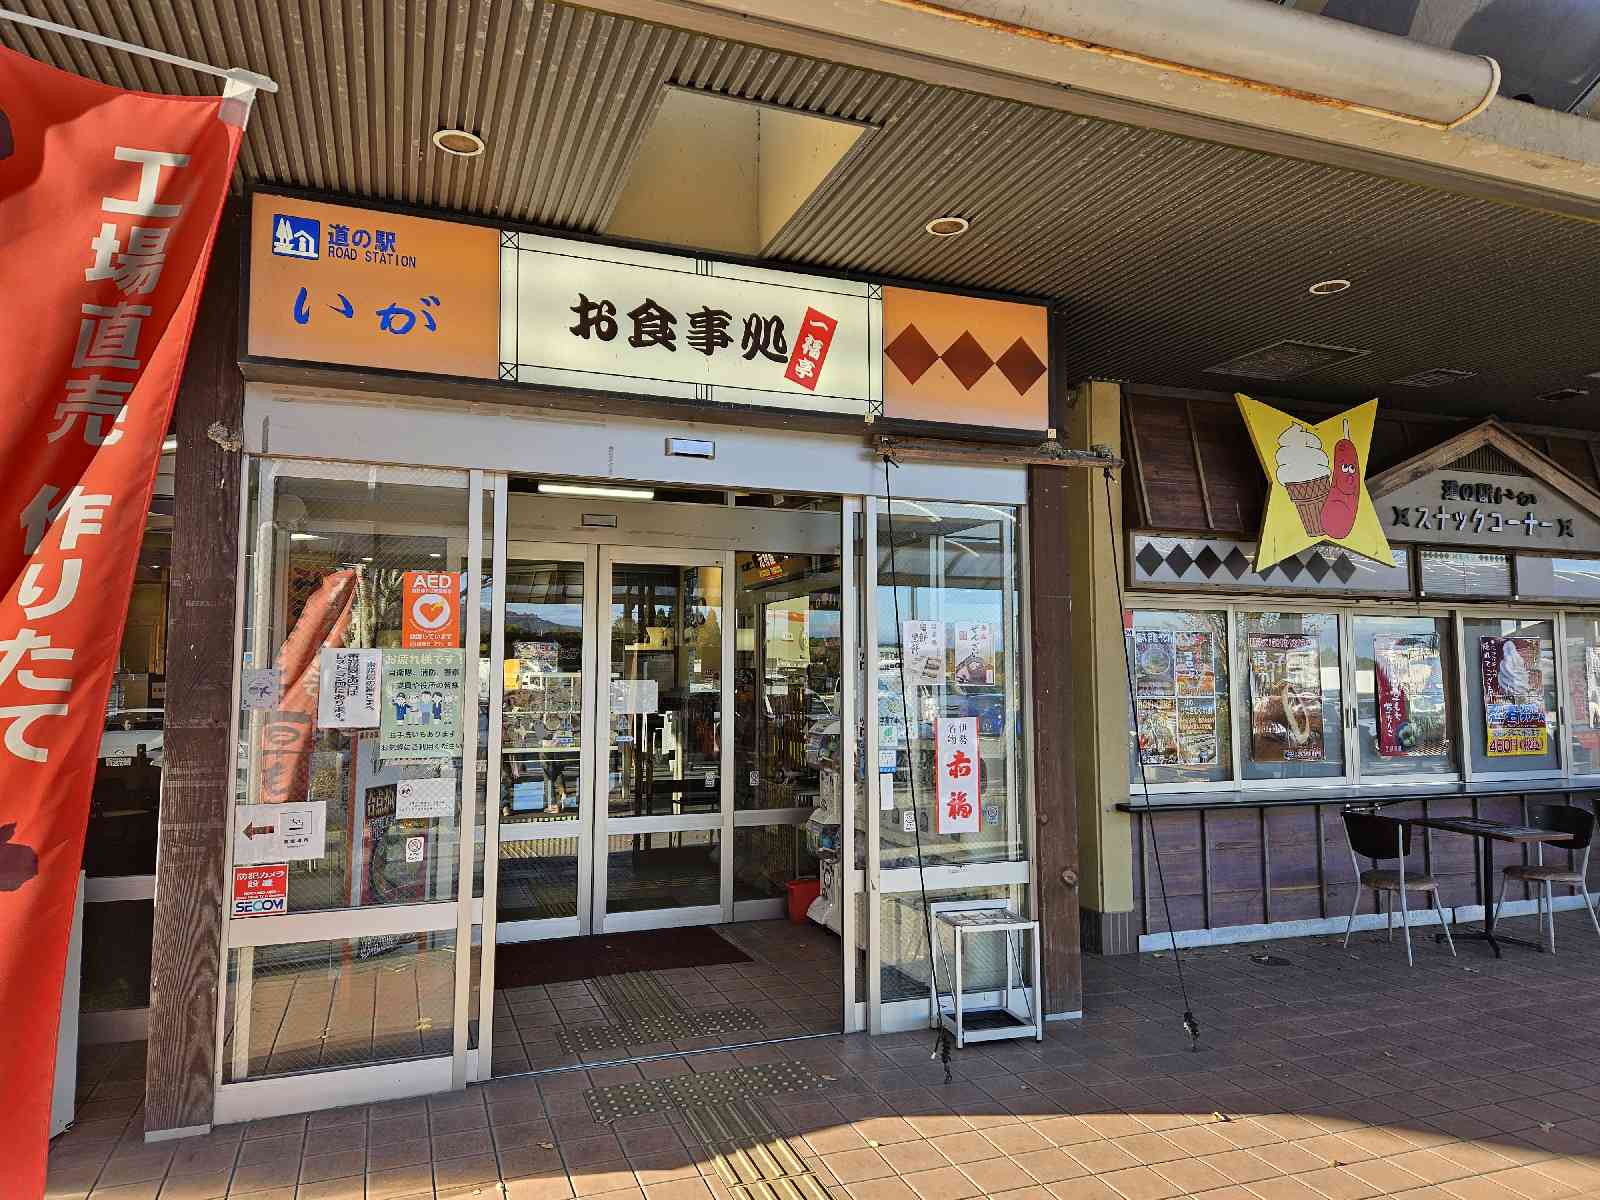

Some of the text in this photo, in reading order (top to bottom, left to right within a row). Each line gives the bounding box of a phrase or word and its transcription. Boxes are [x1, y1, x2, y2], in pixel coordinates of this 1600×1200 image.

[327, 223, 397, 253] 道の駅
[328, 246, 417, 269] ROAD STATION
[293, 287, 441, 335] いが
[569, 292, 789, 364] お食事処
[0, 146, 191, 763] 工場直売 作りたて
[1415, 504, 1553, 536] スナックコーナー
[413, 574, 452, 589] AED
[945, 750, 973, 821] 赤福
[235, 899, 284, 914] SECOM
